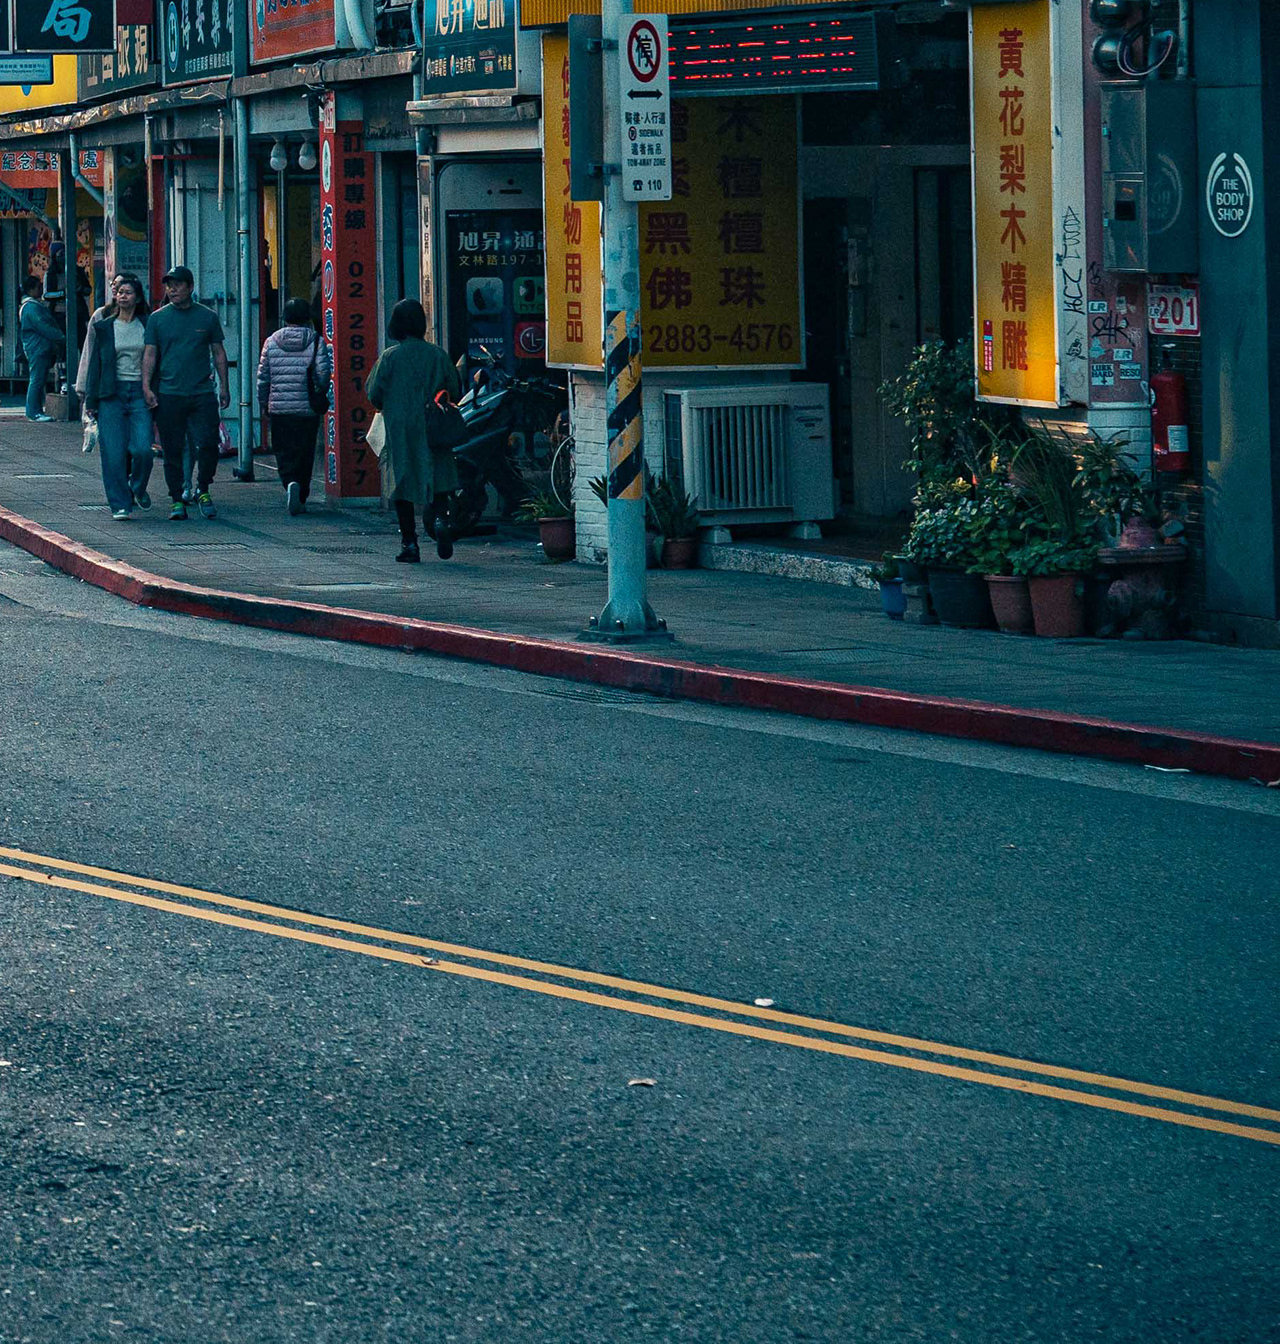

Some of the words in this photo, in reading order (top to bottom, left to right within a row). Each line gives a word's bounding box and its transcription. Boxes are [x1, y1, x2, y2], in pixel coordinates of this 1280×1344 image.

[647, 179, 662, 191] 110
[1222, 178, 1239, 191] THE
[997, 26, 1029, 372] 黃花梨木精雕
[1216, 192, 1245, 207] BODY
[1217, 208, 1245, 222] SHOP
[646, 266, 766, 311] 佛珠
[1158, 296, 1196, 326] 201
[649, 323, 794, 354] 2883-4576
